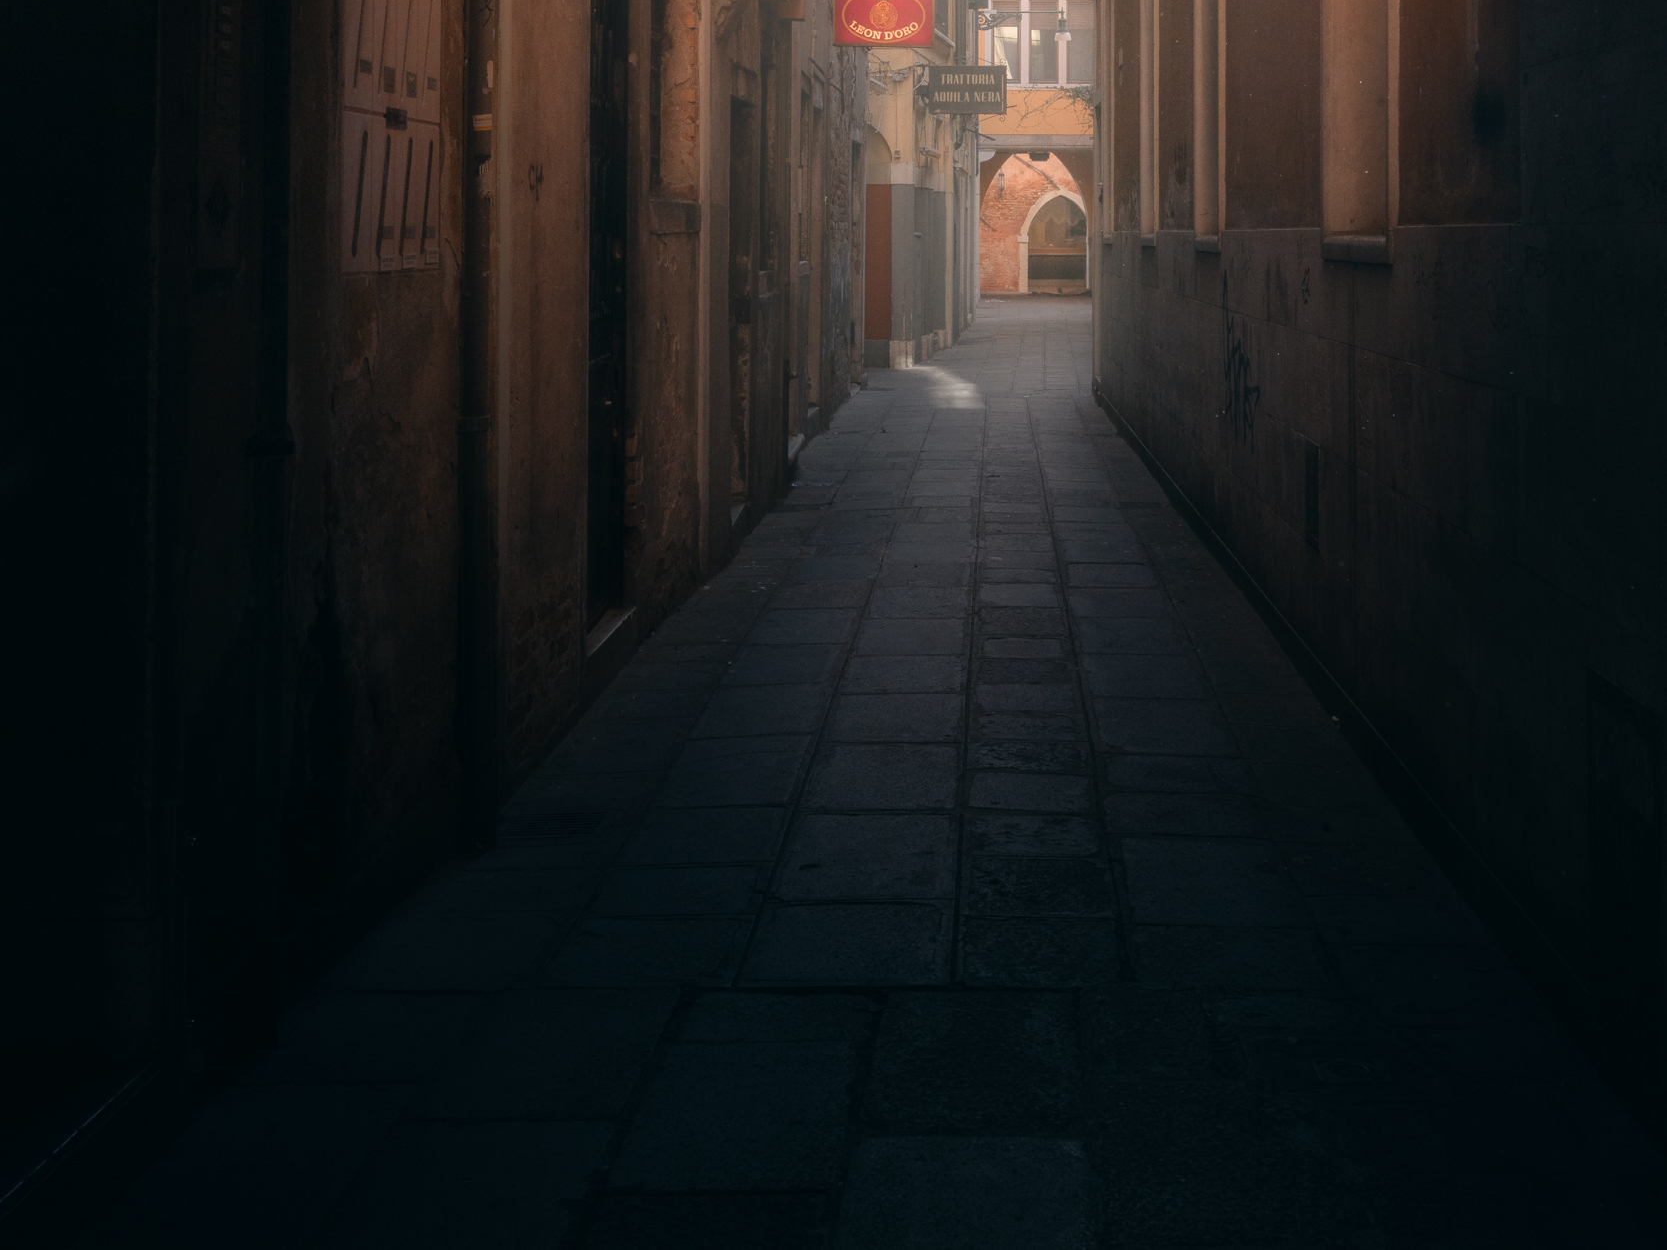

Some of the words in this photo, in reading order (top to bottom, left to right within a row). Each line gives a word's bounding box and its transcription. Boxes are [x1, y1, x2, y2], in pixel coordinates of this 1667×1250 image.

[849, 20, 881, 40] LEON
[884, 21, 919, 40] D'ORO
[941, 73, 995, 85] TRATTORIA
[933, 91, 970, 102] AQUILA
[973, 91, 1001, 102] NERA
